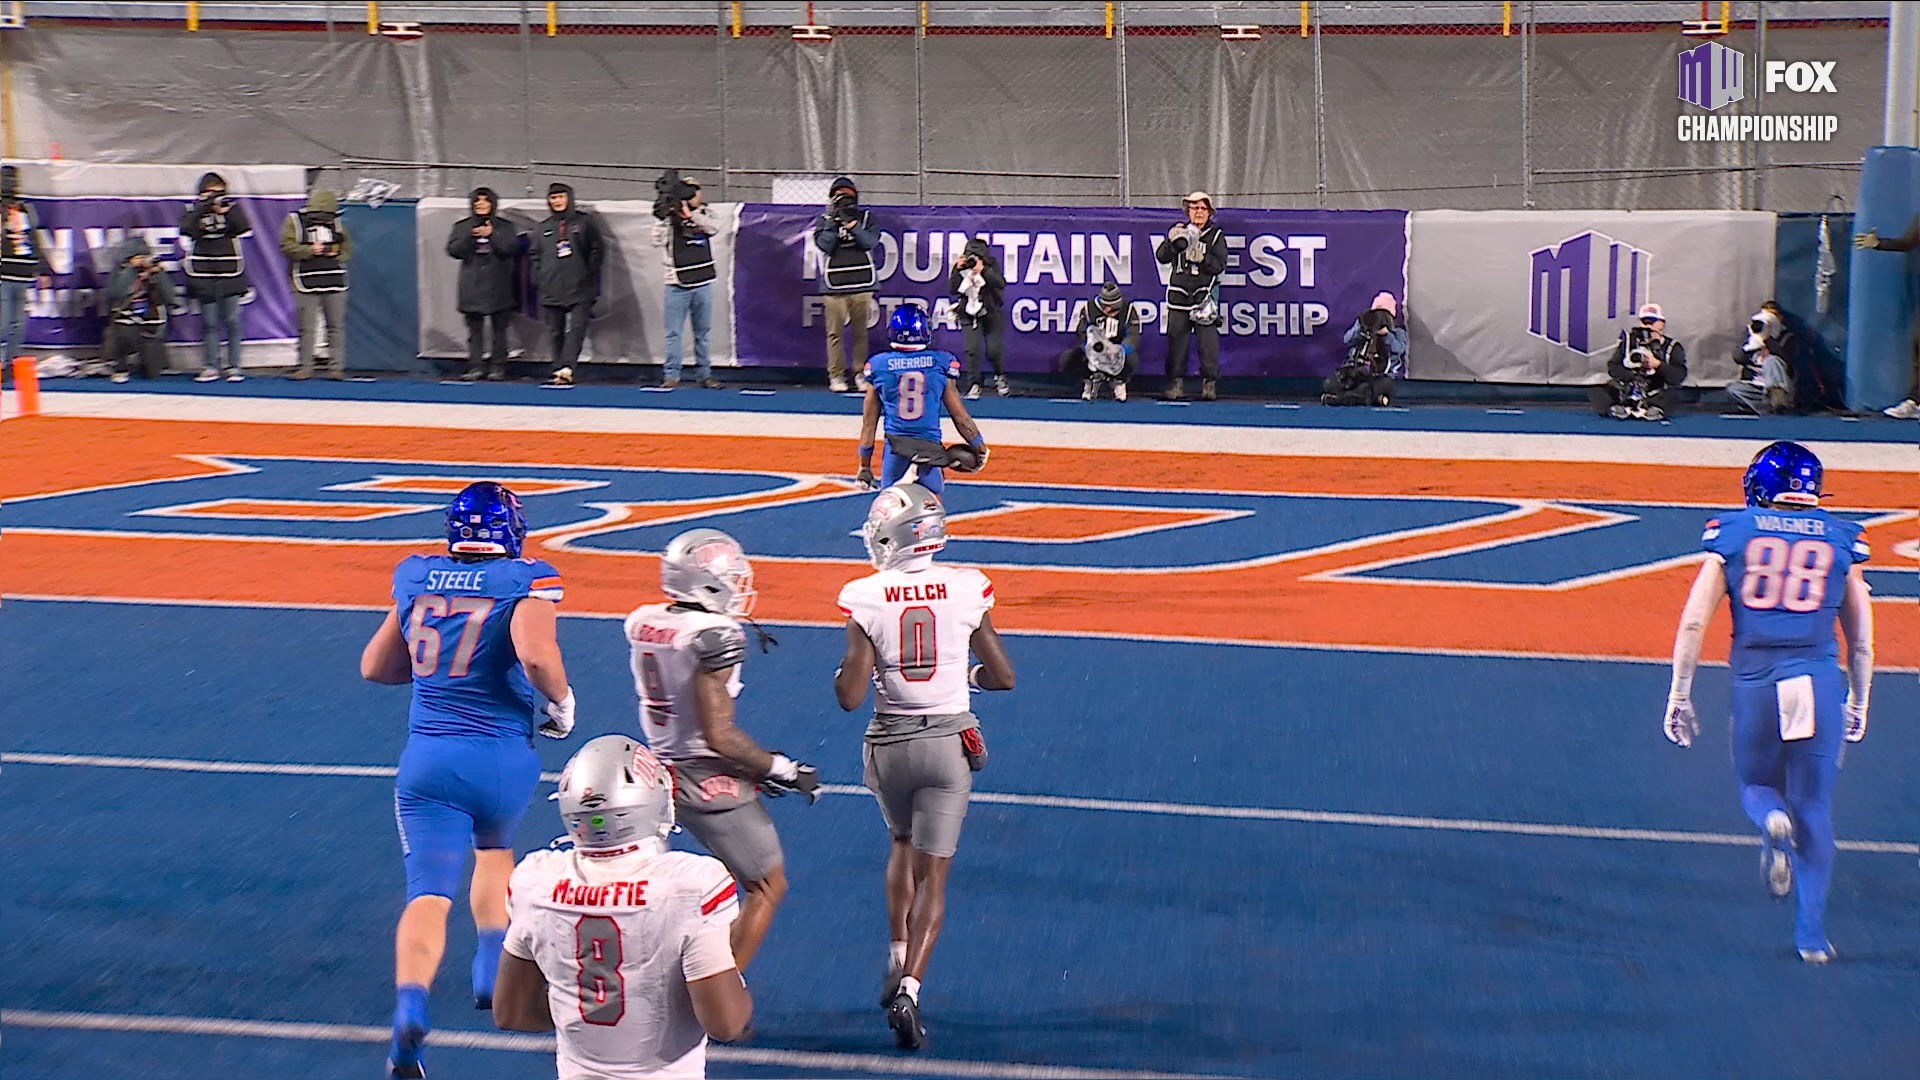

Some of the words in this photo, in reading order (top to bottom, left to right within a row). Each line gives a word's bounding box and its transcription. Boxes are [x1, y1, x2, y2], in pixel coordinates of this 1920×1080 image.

[887, 356, 934, 371] SHERROD
[898, 371, 926, 420] 8
[1753, 514, 1826, 536] WAGNER
[426, 569, 486, 591] STEELE
[884, 583, 948, 603] WELCH
[1740, 536, 1834, 613] 88
[408, 594, 495, 678] 67
[898, 606, 937, 681] 0
[552, 878, 649, 907] McDUFFIE
[575, 913, 626, 1026] 8
